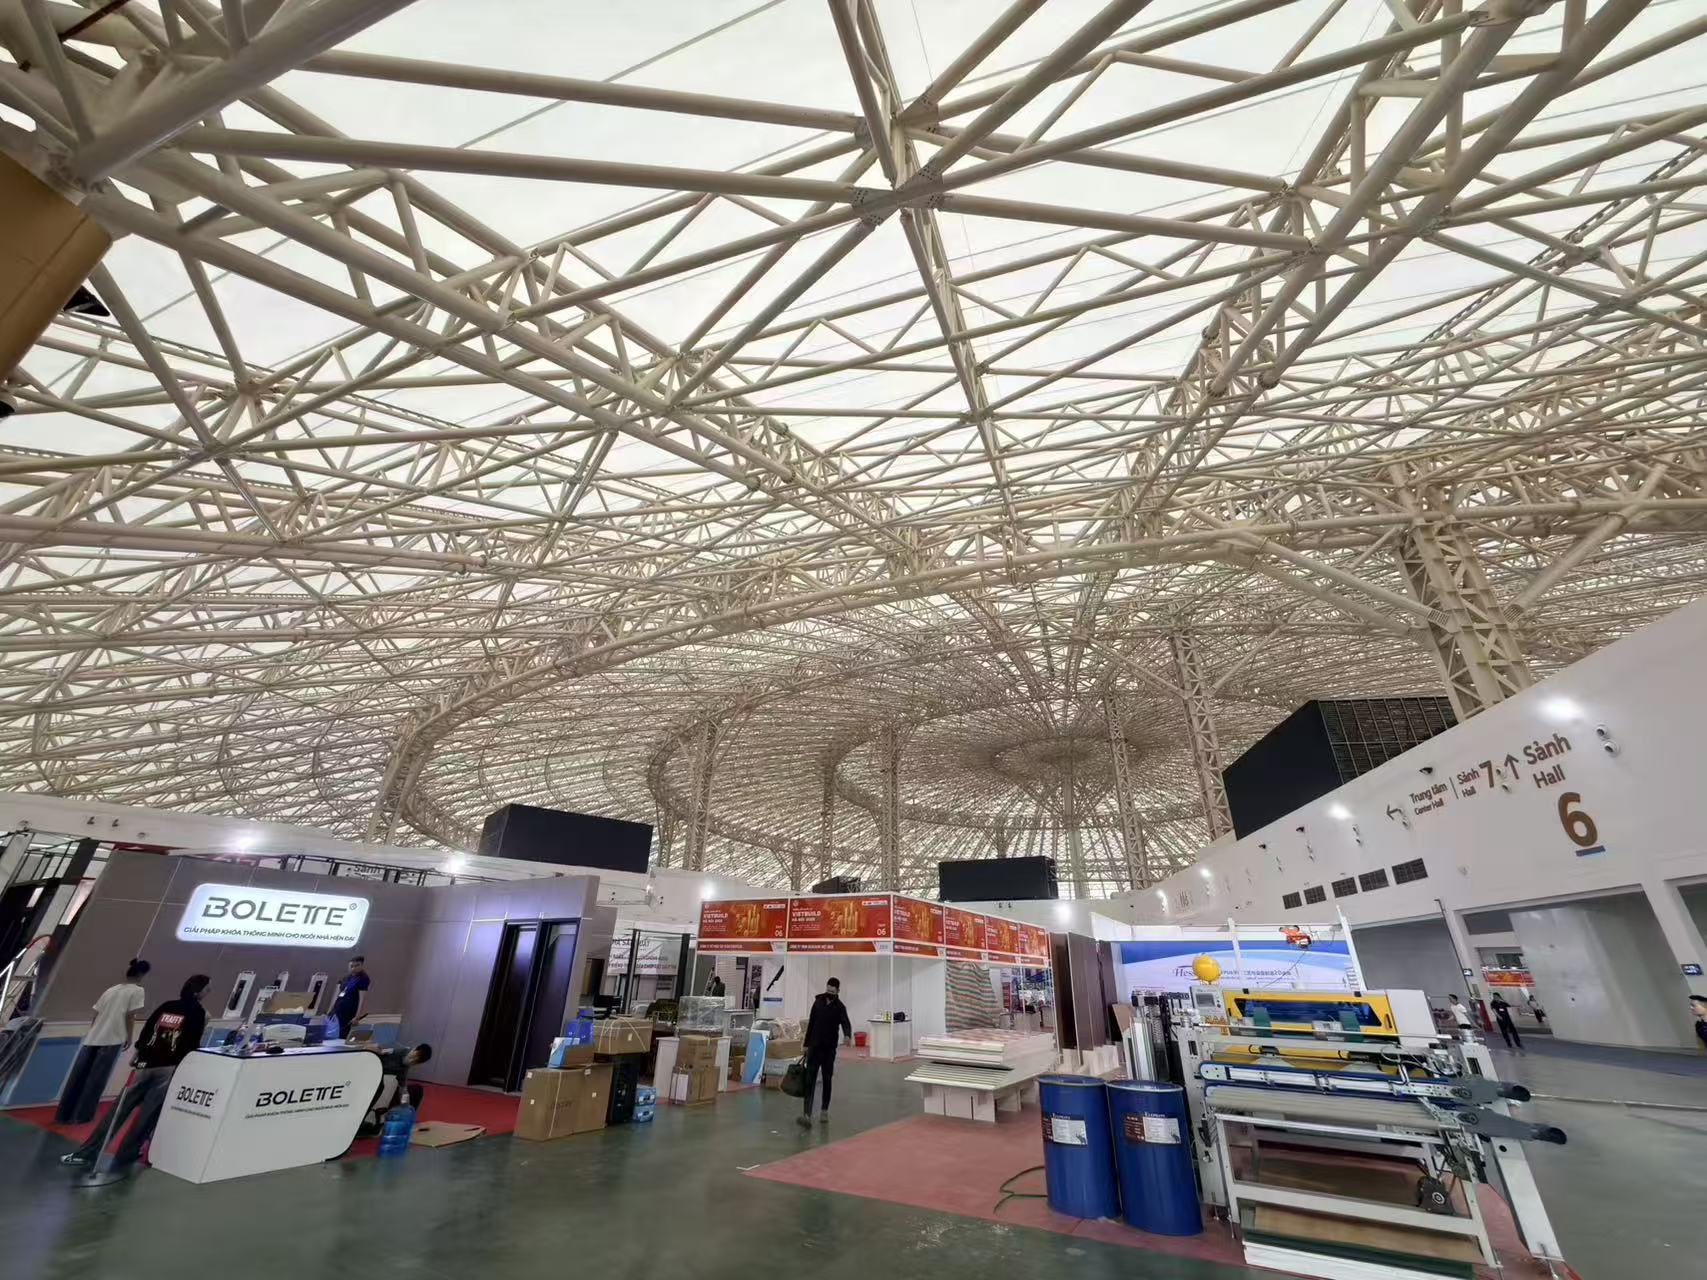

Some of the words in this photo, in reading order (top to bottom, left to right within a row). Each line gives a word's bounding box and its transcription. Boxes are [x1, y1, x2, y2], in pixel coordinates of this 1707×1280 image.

[1523, 733, 1572, 765] Sảnh
[1457, 768, 1480, 785] Sảnh
[1479, 760, 1495, 788] 7
[1533, 764, 1566, 789] Hall
[1409, 790, 1433, 804] Trung
[1461, 786, 1477, 798] Hall
[1431, 798, 1445, 810] Hall
[1558, 791, 1598, 847] 6
[876, 928, 887, 936] 06
